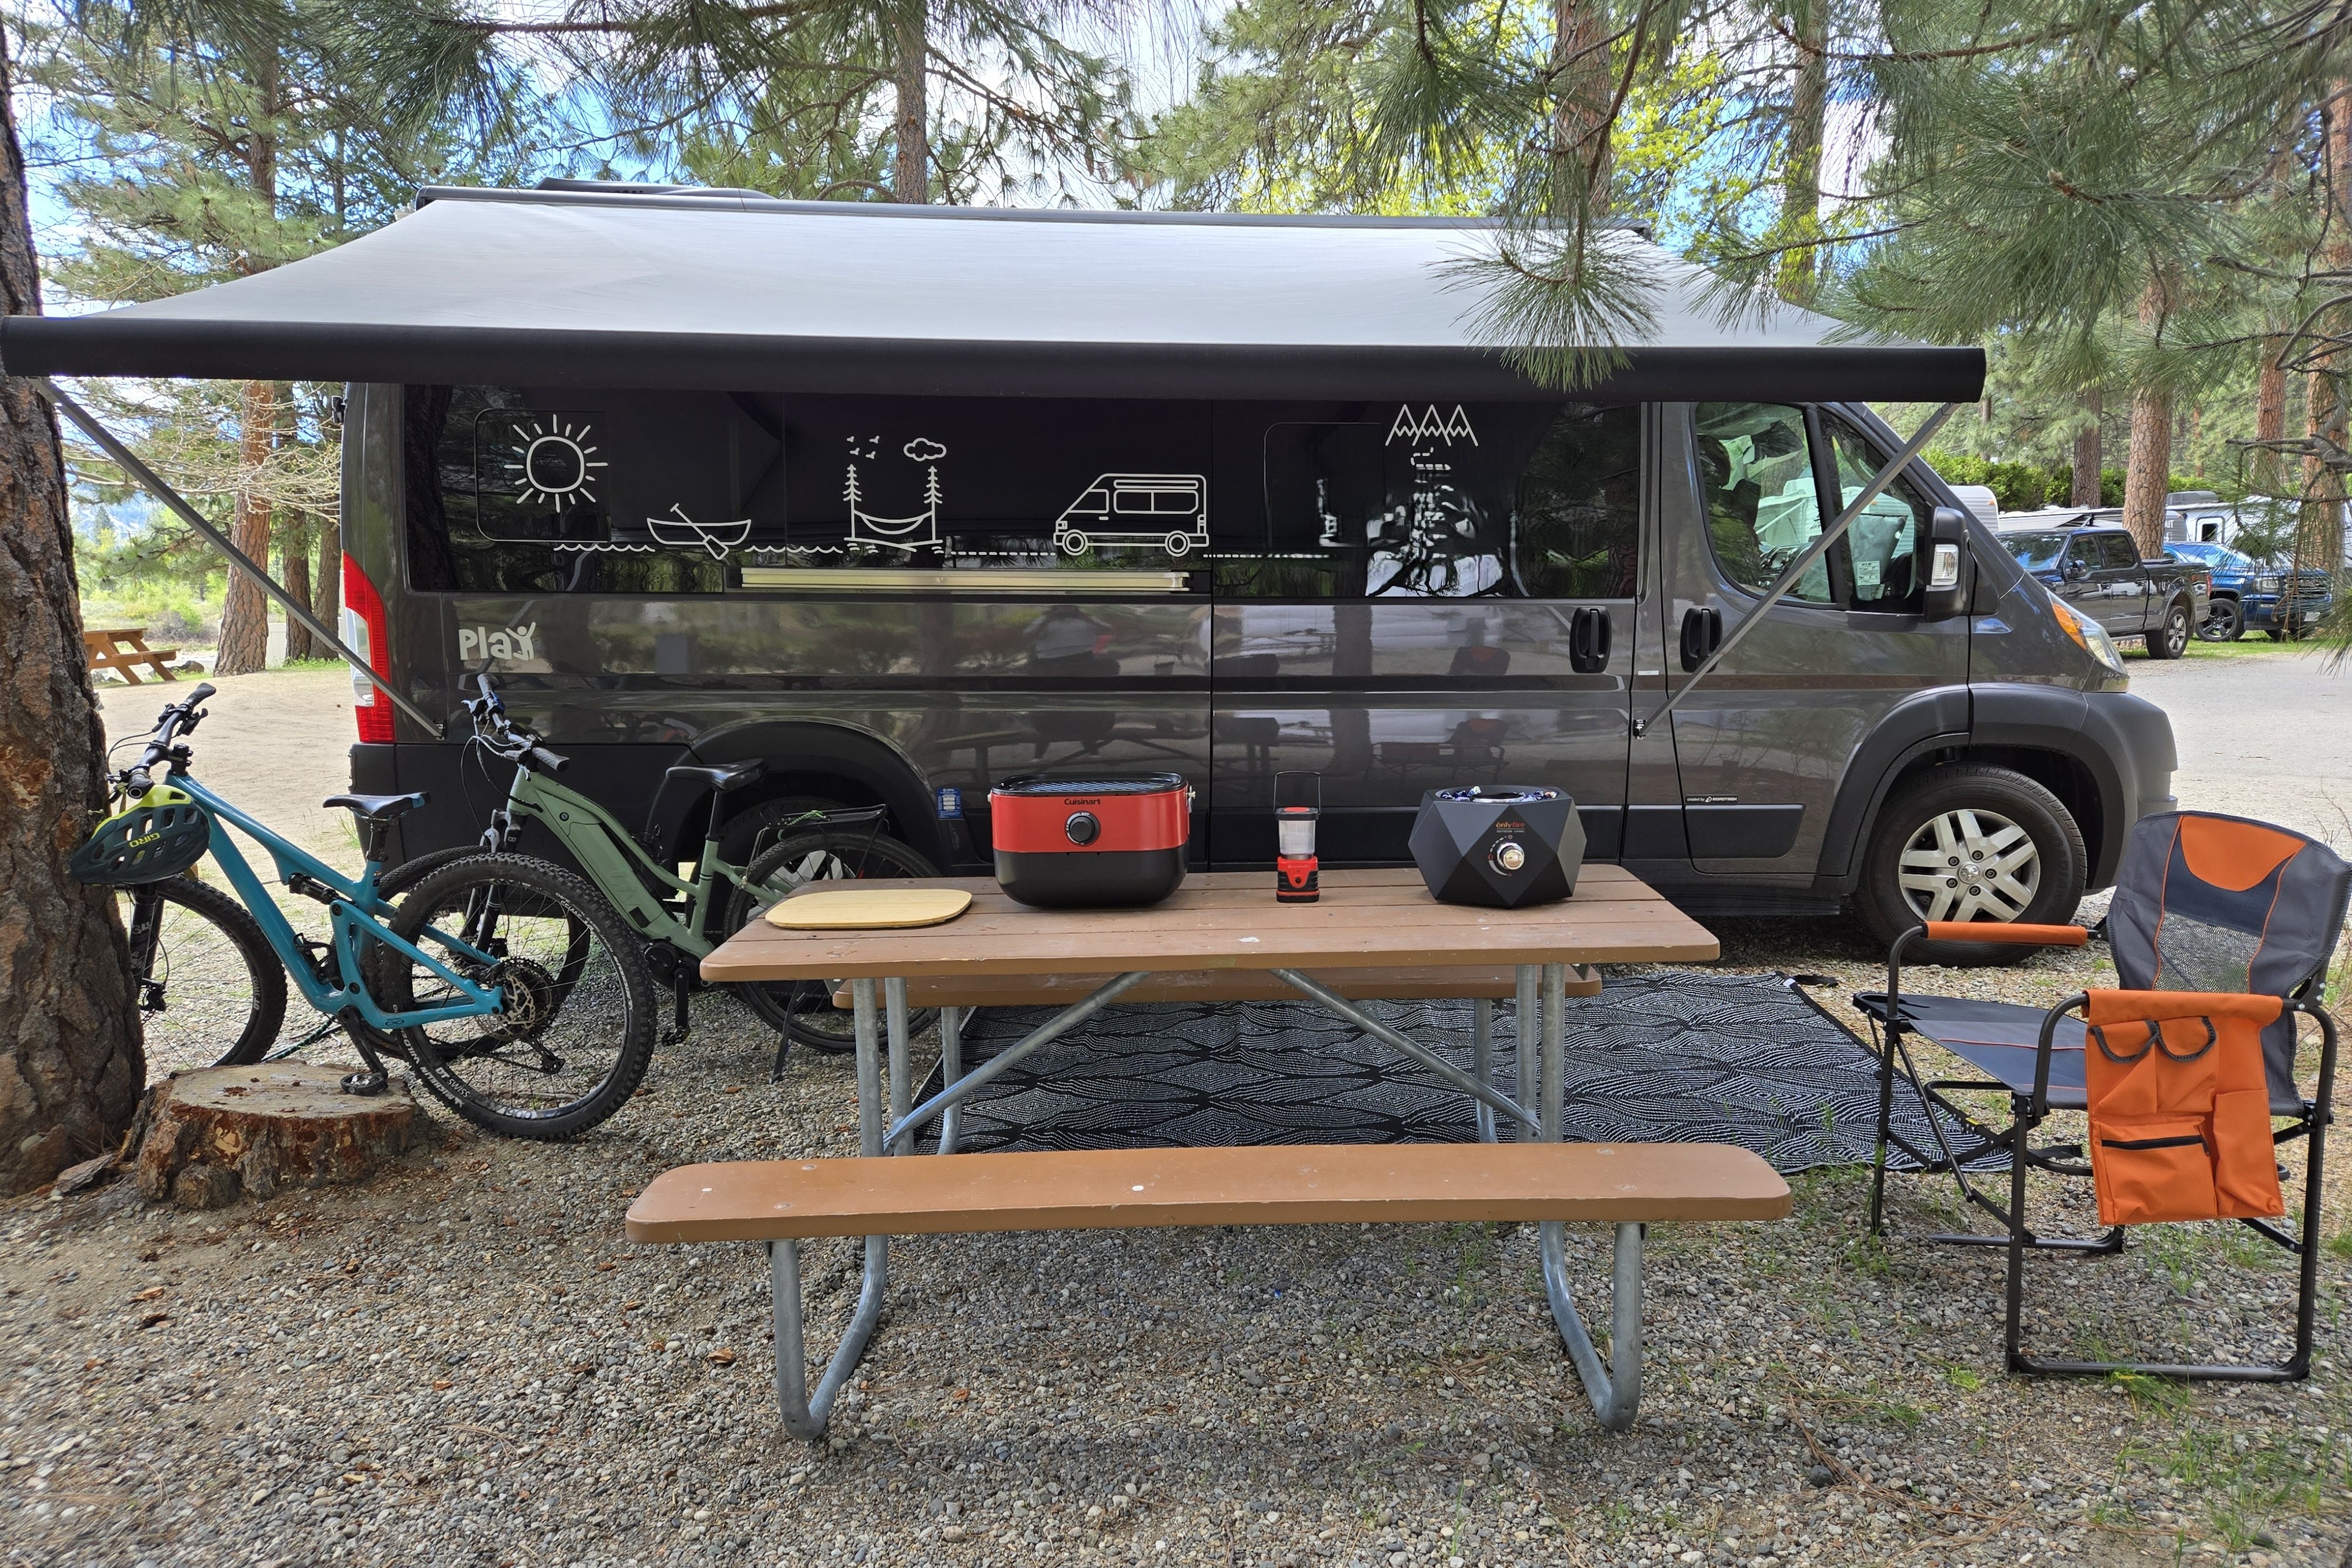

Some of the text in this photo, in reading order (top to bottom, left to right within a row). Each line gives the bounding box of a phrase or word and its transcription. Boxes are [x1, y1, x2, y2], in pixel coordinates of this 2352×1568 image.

[129, 833, 160, 848] GIRO
[252, 976, 260, 1011] DT SWISS
[403, 1039, 420, 1064] WILD
[420, 1066, 456, 1100] MICHELIN
[435, 1066, 470, 1097] DT SWISS
